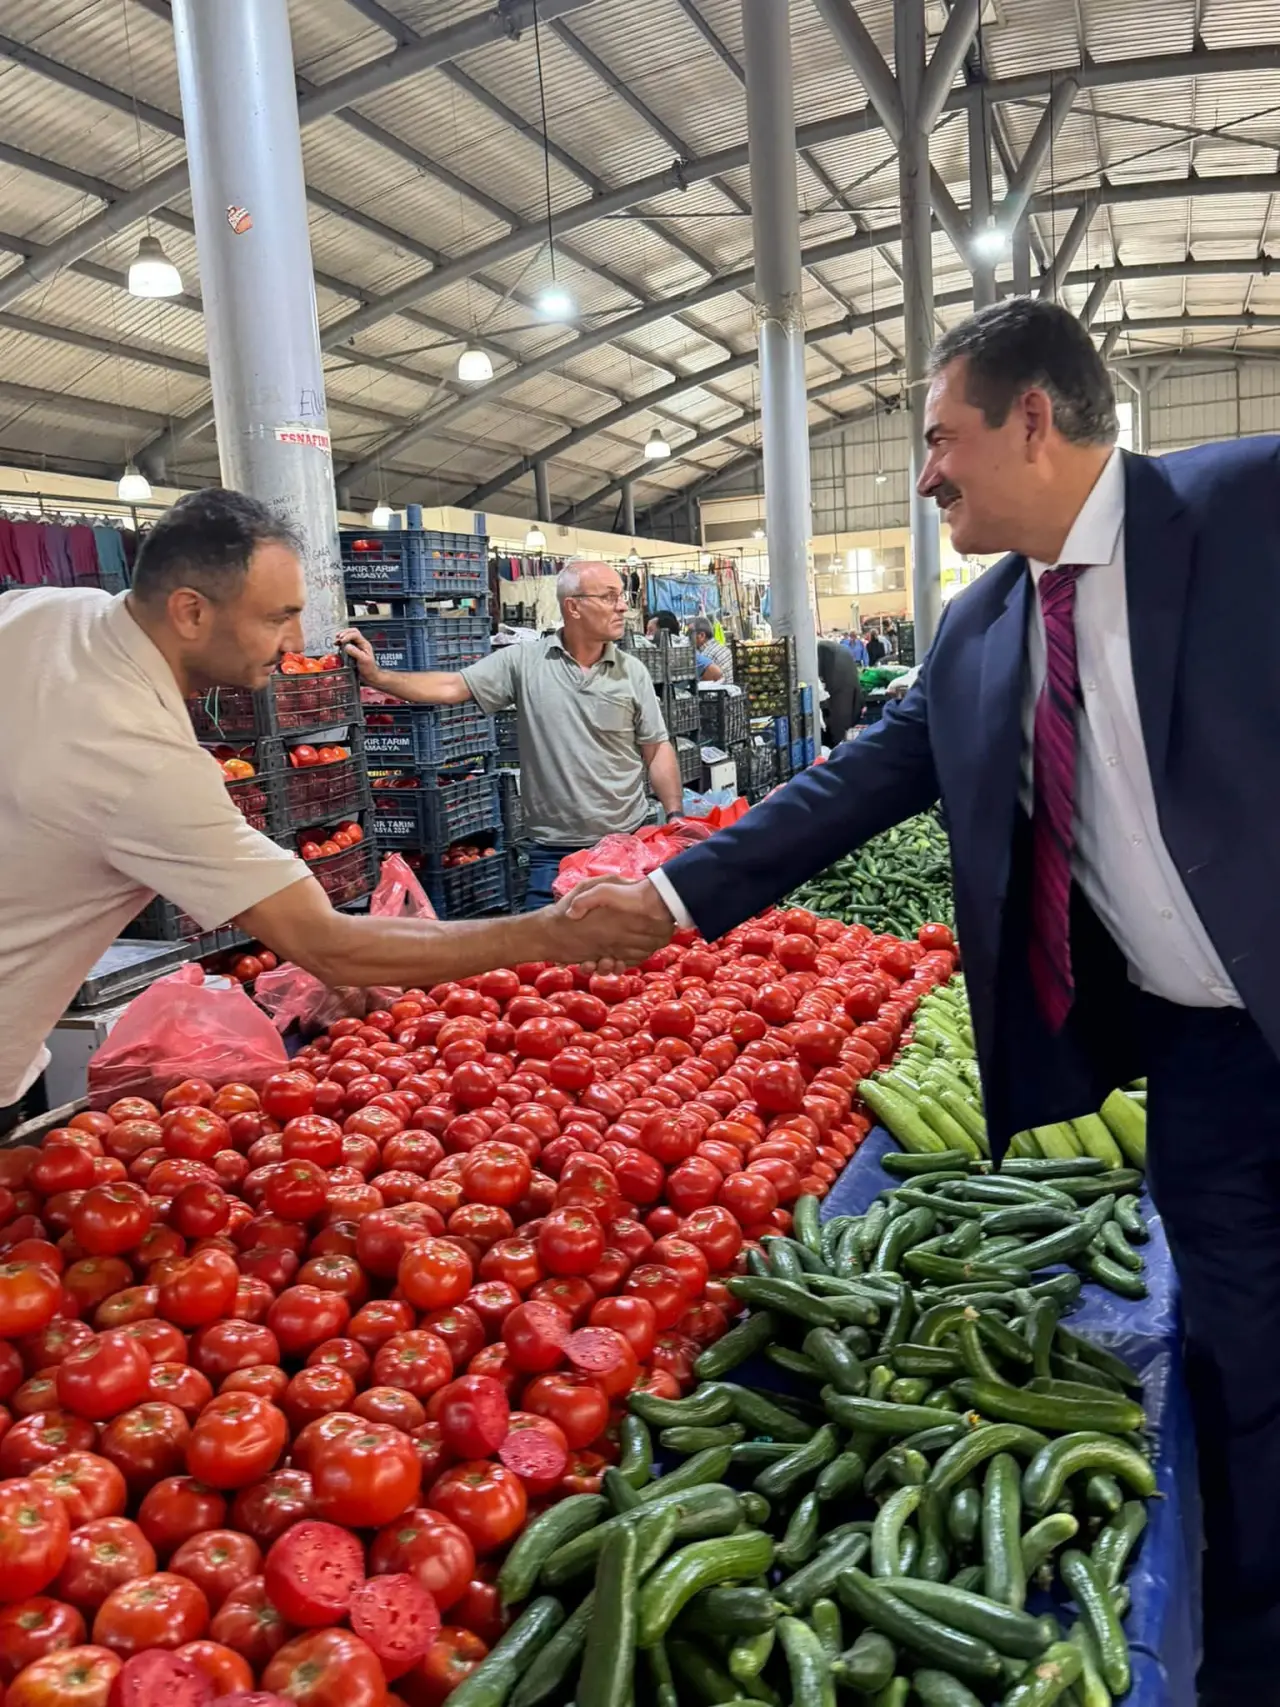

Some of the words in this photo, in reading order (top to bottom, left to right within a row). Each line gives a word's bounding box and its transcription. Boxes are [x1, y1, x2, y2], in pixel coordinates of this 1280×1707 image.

[375, 653, 402, 661] TARIM
[381, 738, 409, 746] TARIM
[387, 821, 414, 829] TARIM
